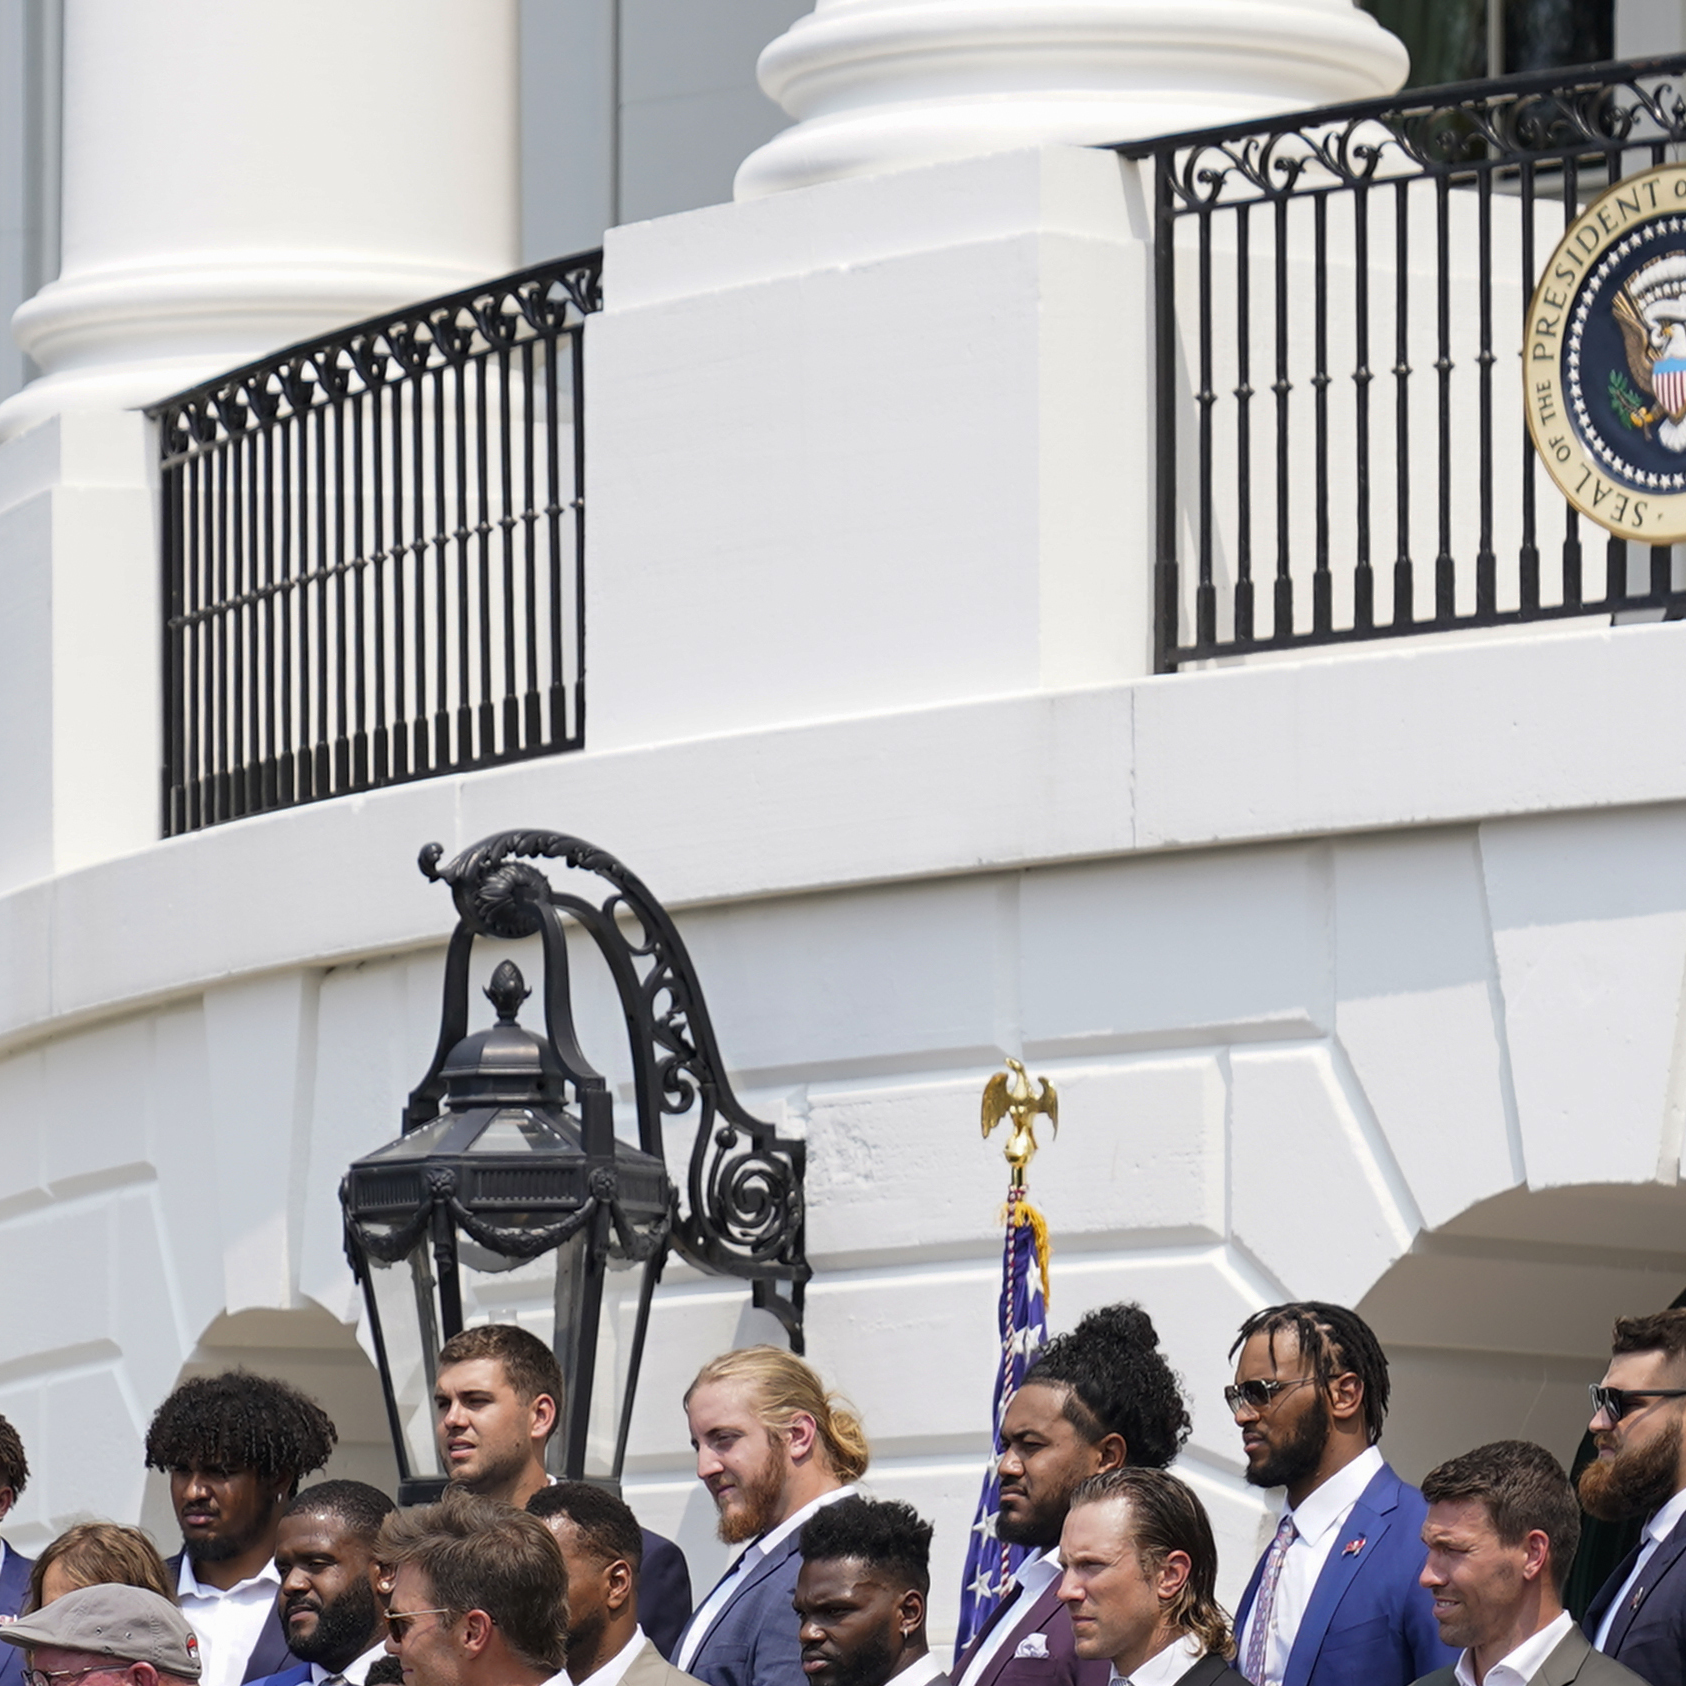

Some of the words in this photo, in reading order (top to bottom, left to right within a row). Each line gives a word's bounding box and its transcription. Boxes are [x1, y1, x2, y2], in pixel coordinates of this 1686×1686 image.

[1533, 178, 1660, 362] PRESIDENT
[1536, 380, 1556, 425] THE
[1548, 434, 1570, 462] OF
[1572, 463, 1648, 528] SEAL
